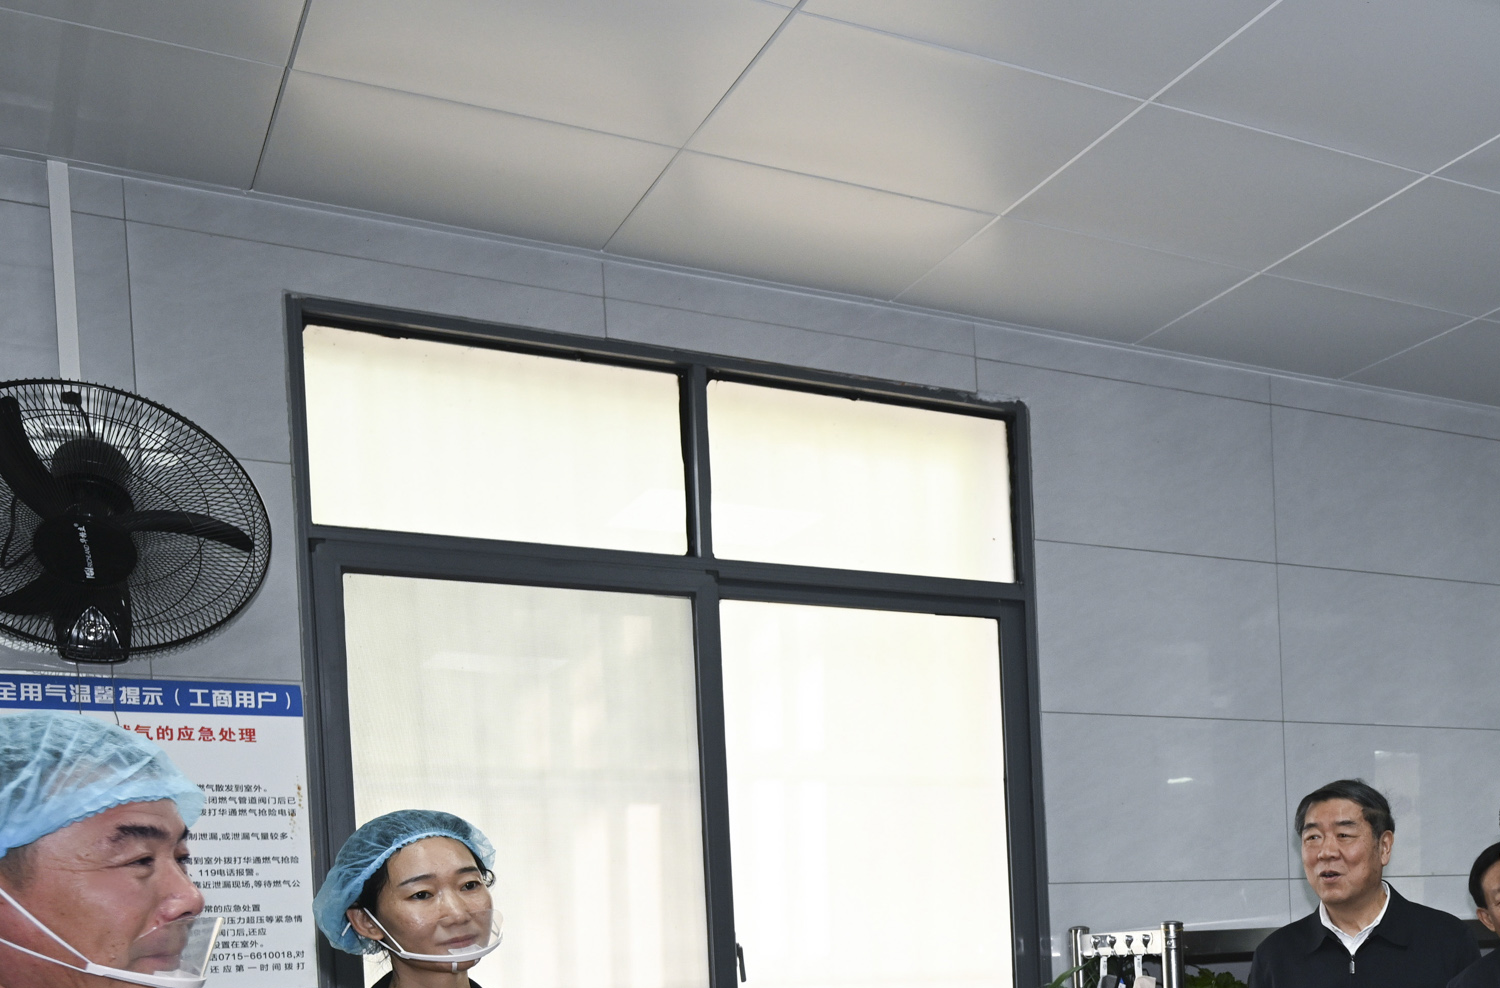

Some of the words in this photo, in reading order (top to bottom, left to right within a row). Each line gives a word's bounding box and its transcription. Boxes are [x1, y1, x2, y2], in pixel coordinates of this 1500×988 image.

[122, 724, 257, 743] 气的应急处理
[204, 796, 296, 805] 闭燃气管道阀门后已
[185, 832, 293, 841] 制泄漏,或泄漏气量较多、
[204, 903, 261, 913] 常的应急处置
